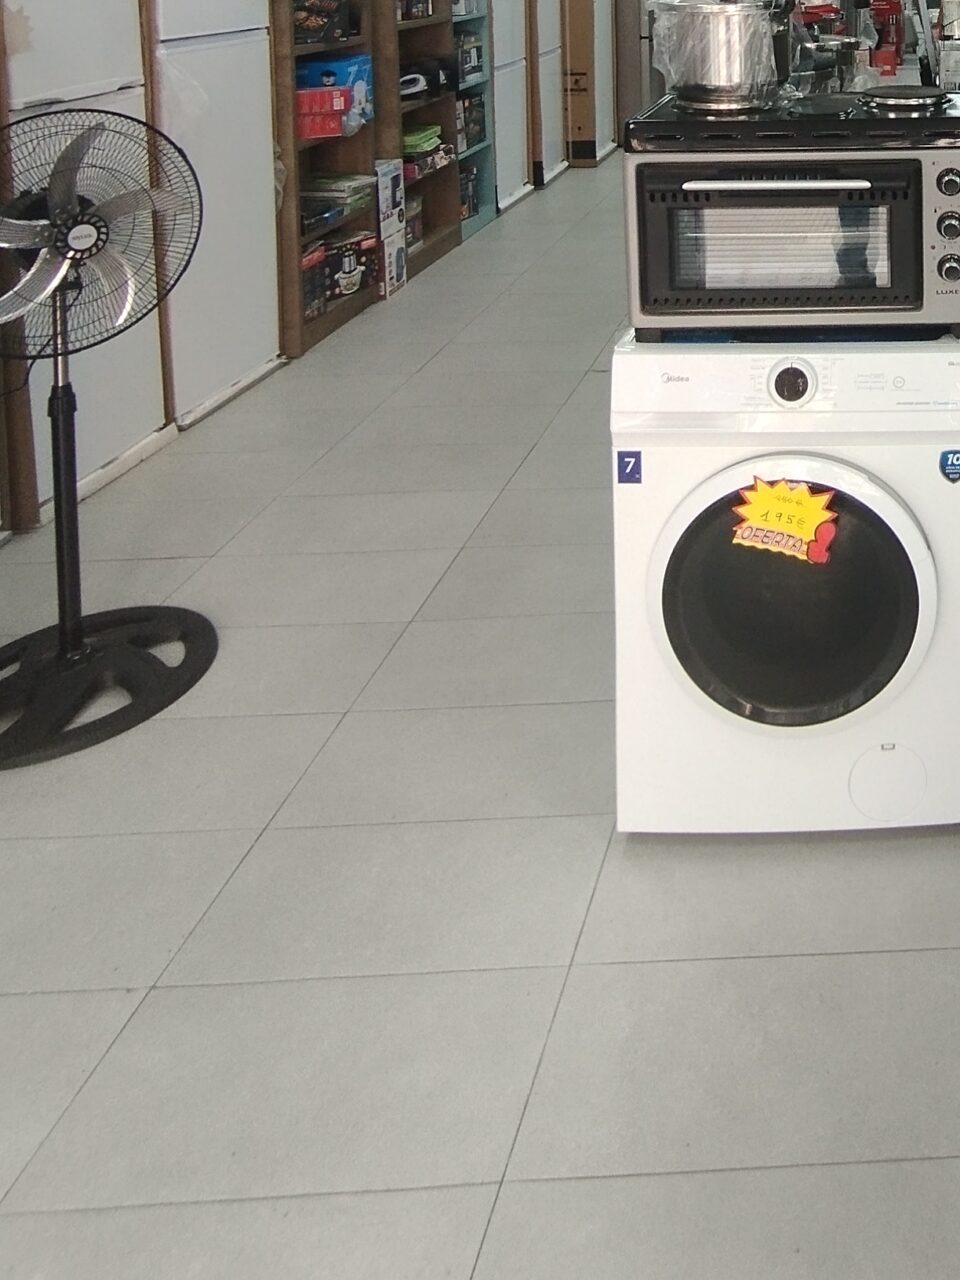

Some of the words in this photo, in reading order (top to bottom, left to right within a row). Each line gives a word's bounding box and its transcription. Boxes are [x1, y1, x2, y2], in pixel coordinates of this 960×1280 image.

[662, 372, 690, 384] Midea
[624, 457, 636, 473] 7
[760, 510, 806, 530] 195€
[741, 526, 803, 554] OFERTA
